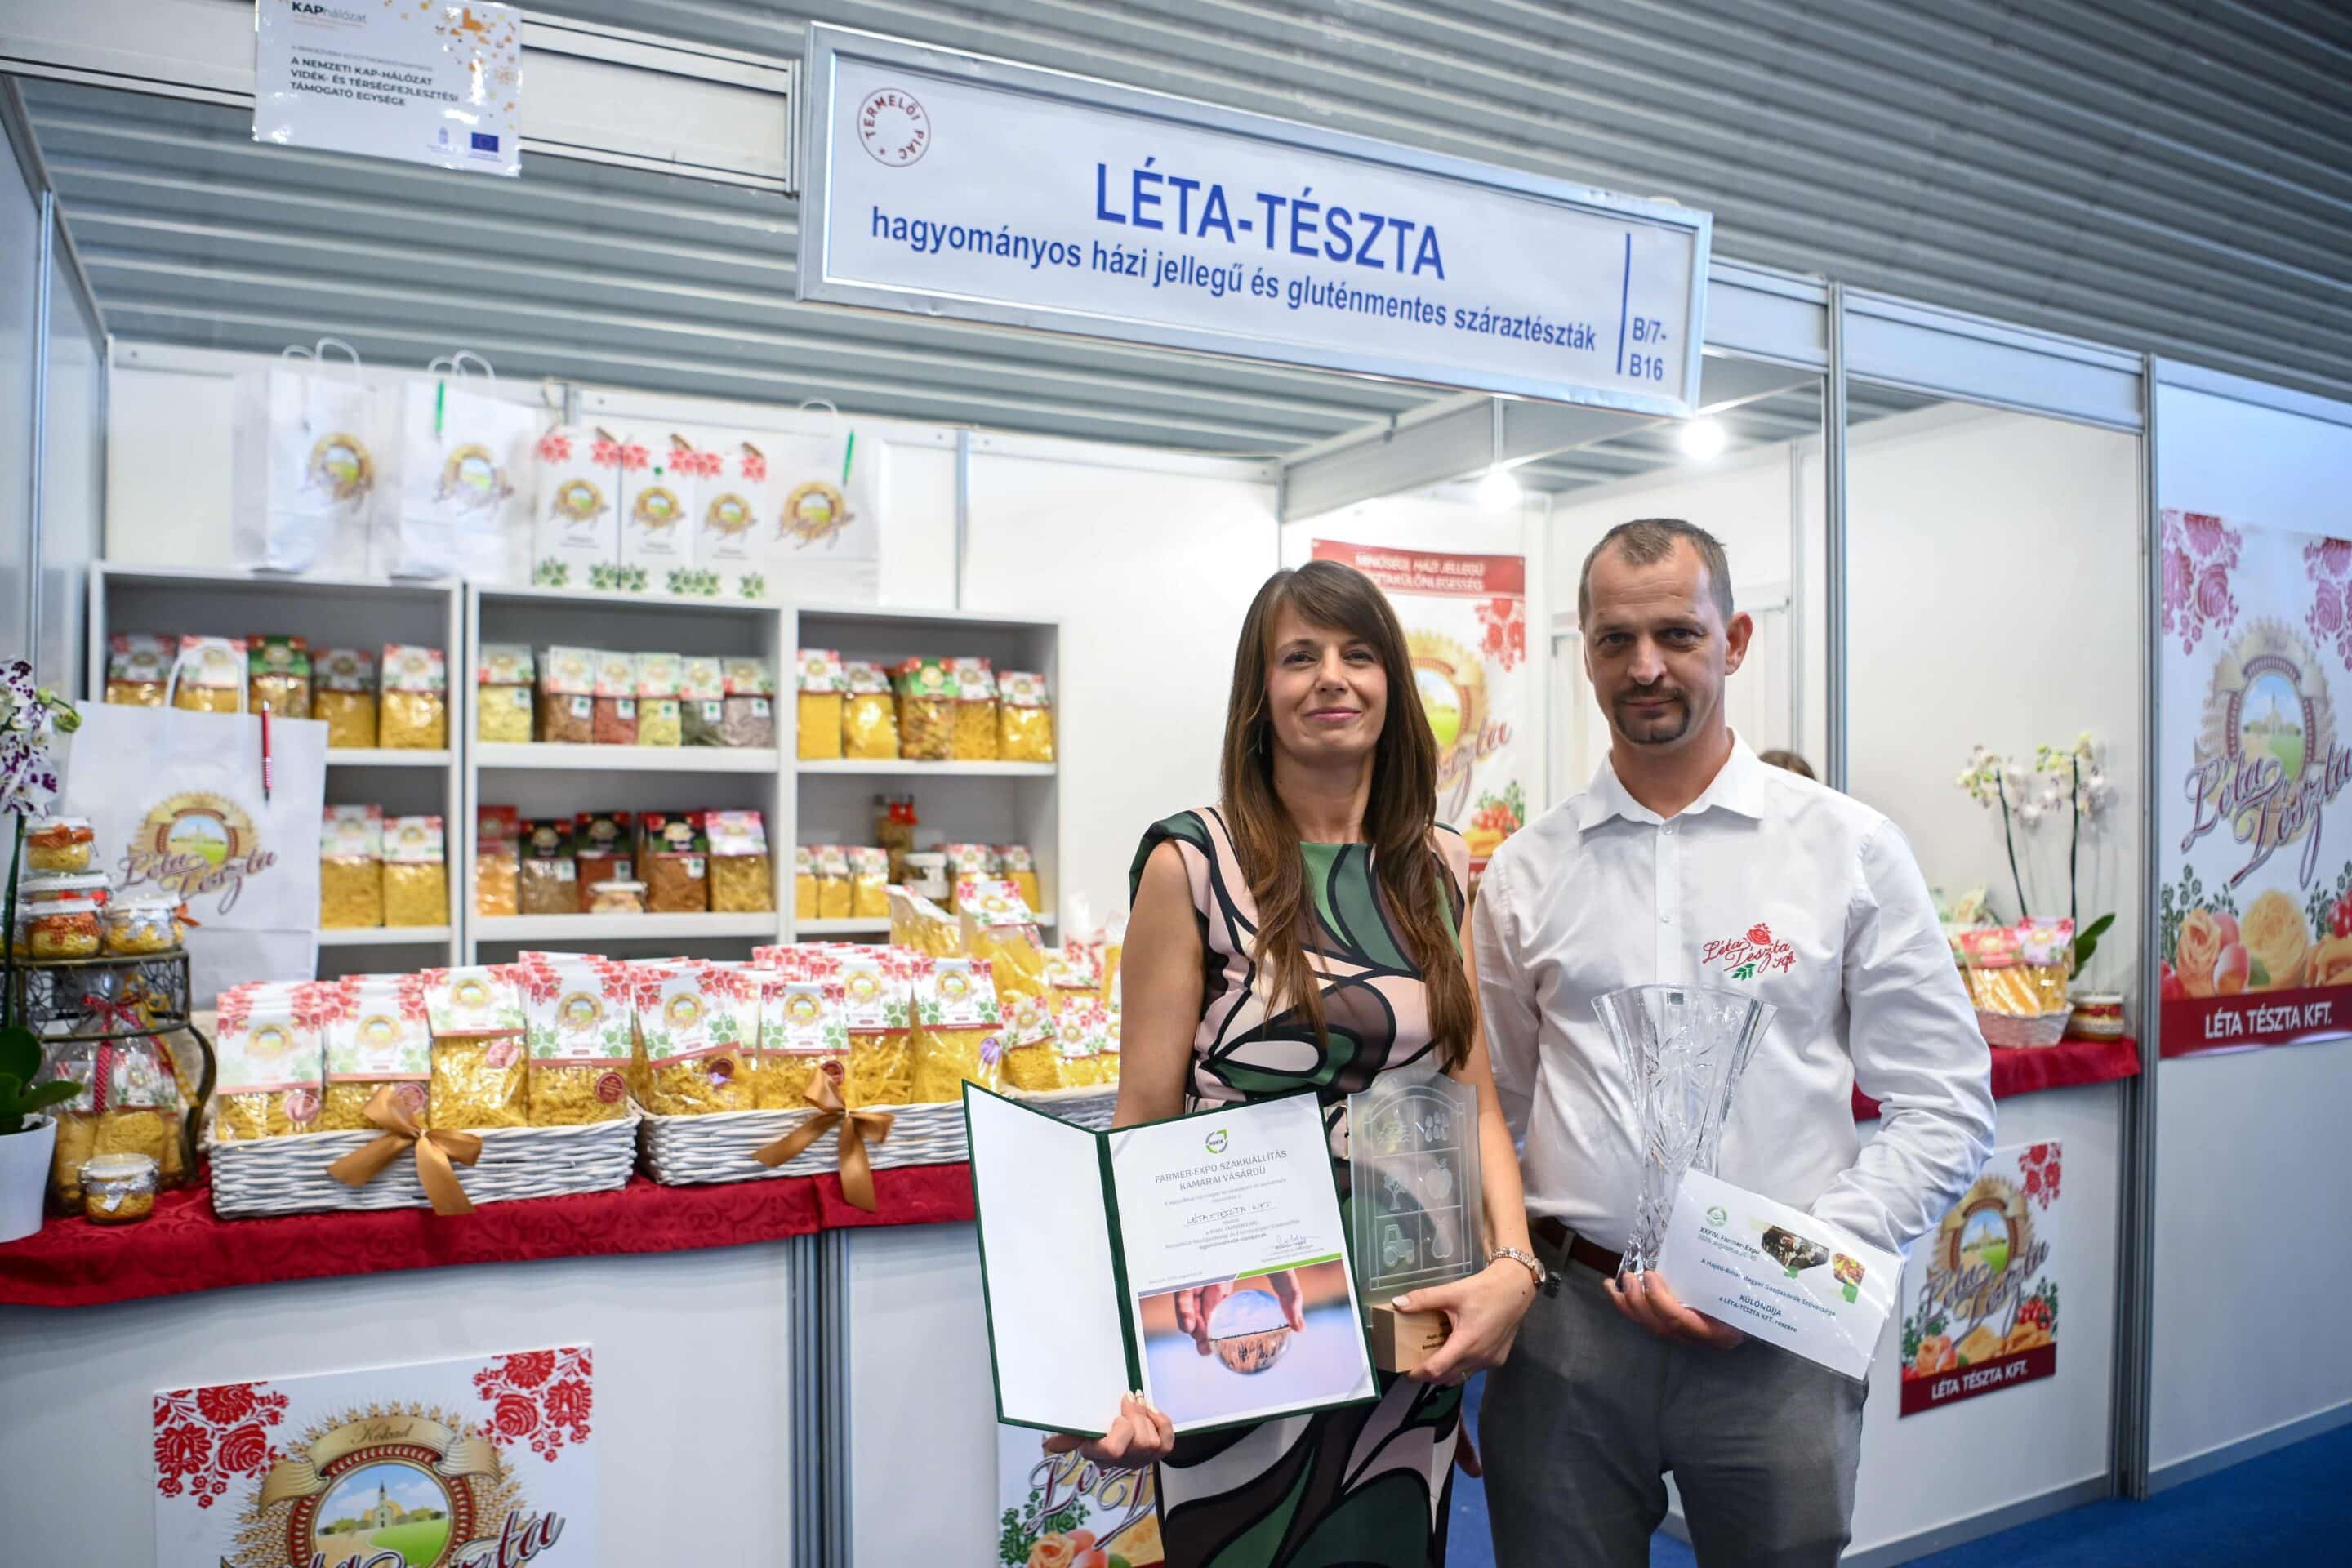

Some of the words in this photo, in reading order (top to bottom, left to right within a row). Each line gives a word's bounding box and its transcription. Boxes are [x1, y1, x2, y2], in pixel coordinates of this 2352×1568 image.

[290, 56, 300, 66] A
[301, 58, 352, 74] NEMZETI
[354, 67, 433, 87] KAP-HÁLÓZAT
[290, 80, 354, 100] TÁMOGATÓ
[356, 91, 407, 107] EGYSÉGE
[332, 73, 346, 86] ÉS
[349, 76, 460, 103] TÉRSÉGFEJLESZTÉSI
[898, 129, 926, 161] PIAC
[1096, 156, 1446, 282] LÉTA-TÉSZTA
[871, 204, 1083, 270] hagyományos
[1091, 240, 1147, 278] házi
[1152, 249, 1244, 298] jellegű
[1250, 262, 1280, 300] és
[1287, 275, 1448, 327] gluténmentes
[1454, 306, 1597, 352] száraztészták
[1632, 316, 1667, 345] B/7-
[1628, 352, 1664, 382] B16
[2180, 748, 2265, 855] Léta
[1702, 938, 1744, 964] Léta
[1723, 938, 1791, 974] Tészta
[2205, 1005, 2243, 1040] LÉTA
[2246, 1001, 2301, 1036] TÉSZTA
[2304, 1000, 2332, 1028] KFT.
[1155, 1163, 1218, 1184] FARMER-EXPO
[1179, 1174, 1221, 1191] KAMARAI
[1221, 1165, 1267, 1183] VÁSÁRDÍJ
[1738, 1294, 1783, 1317] KÜLÖNDÍJA
[1931, 1376, 1961, 1401] LÉTA
[1962, 1366, 2003, 1393] TÉSZTA
[2004, 1359, 2029, 1381] KFT.
